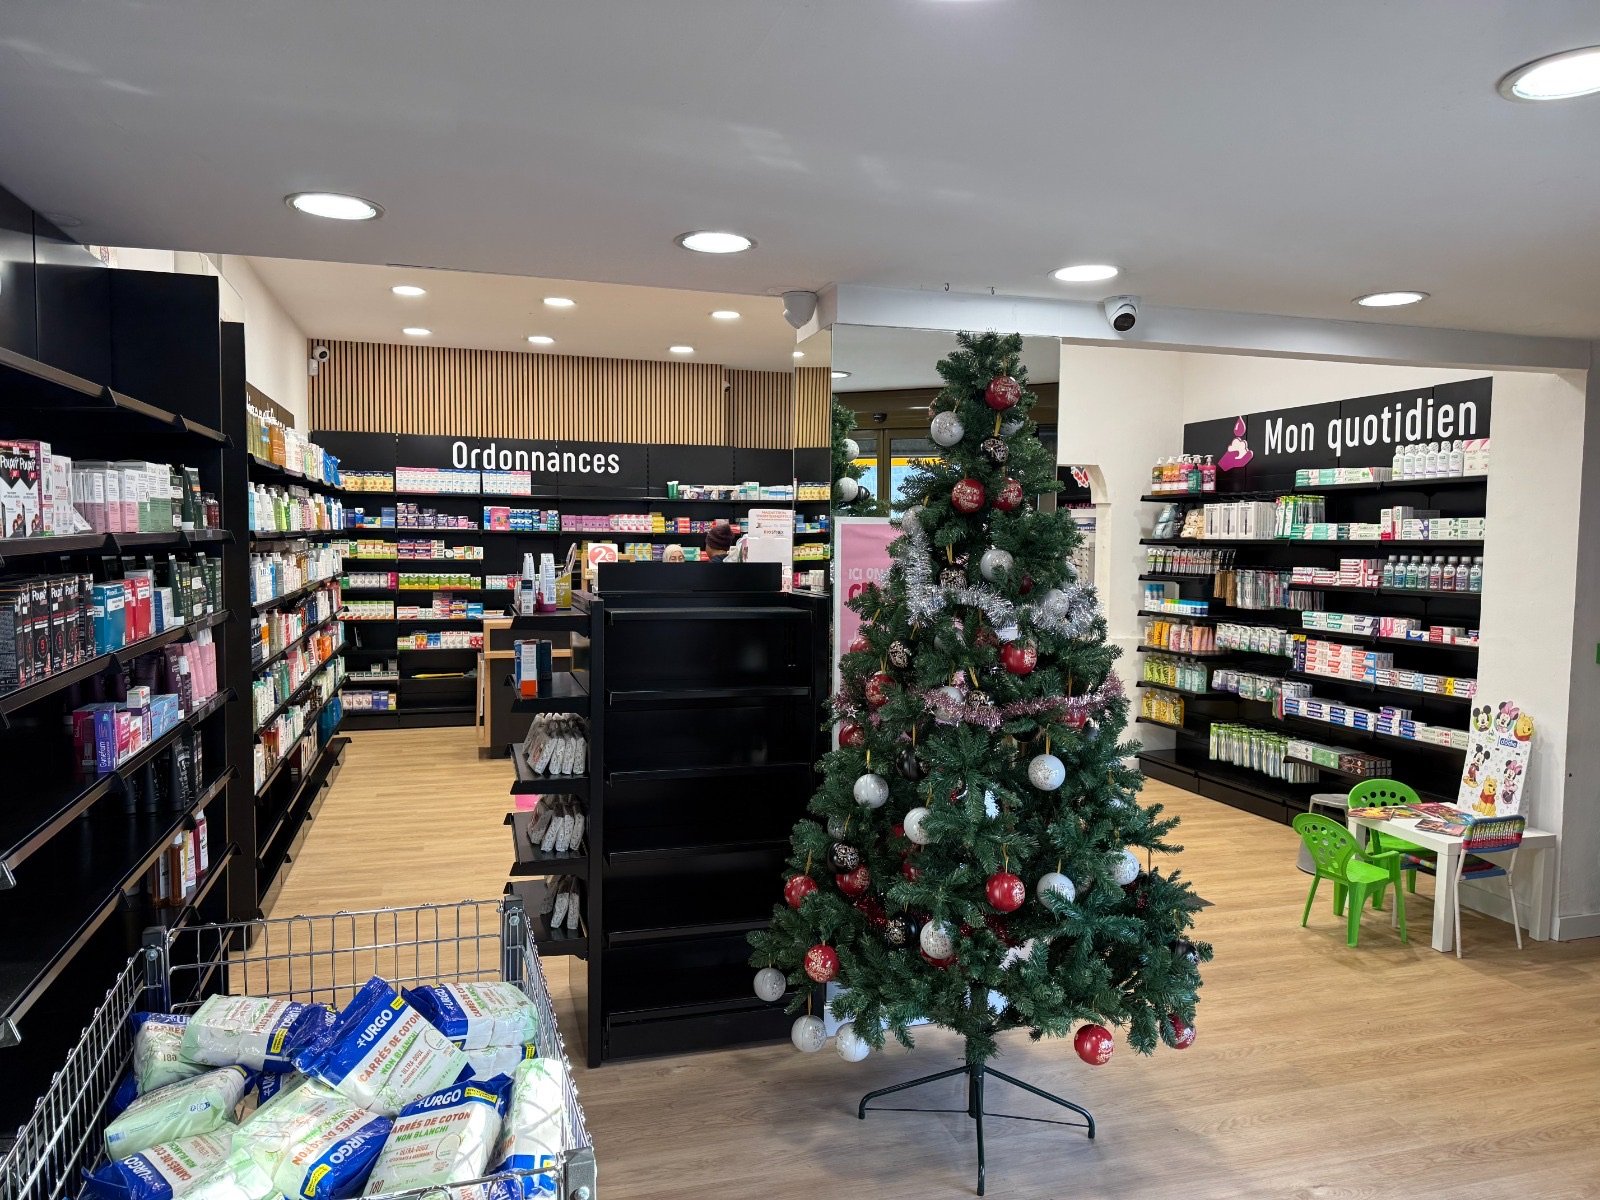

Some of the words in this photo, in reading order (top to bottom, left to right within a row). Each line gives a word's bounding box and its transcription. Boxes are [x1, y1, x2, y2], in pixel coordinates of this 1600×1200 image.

[1265, 416, 1315, 456] Mon
[1327, 397, 1478, 458] quotidien
[452, 441, 620, 474] Ordonnances
[593, 547, 614, 563] 2€
[848, 568, 862, 580] ICI
[361, 1008, 395, 1044] URGO
[356, 1044, 393, 1083] CARRÉS
[389, 1035, 402, 1048] DE
[397, 1011, 421, 1037] COTON
[423, 1089, 463, 1108] URGO
[390, 1119, 422, 1134] ARRÉS
[423, 1117, 438, 1127] DE
[438, 1111, 472, 1124] COTON
[394, 1132, 411, 1142] NON
[413, 1125, 450, 1138] BLANCHI
